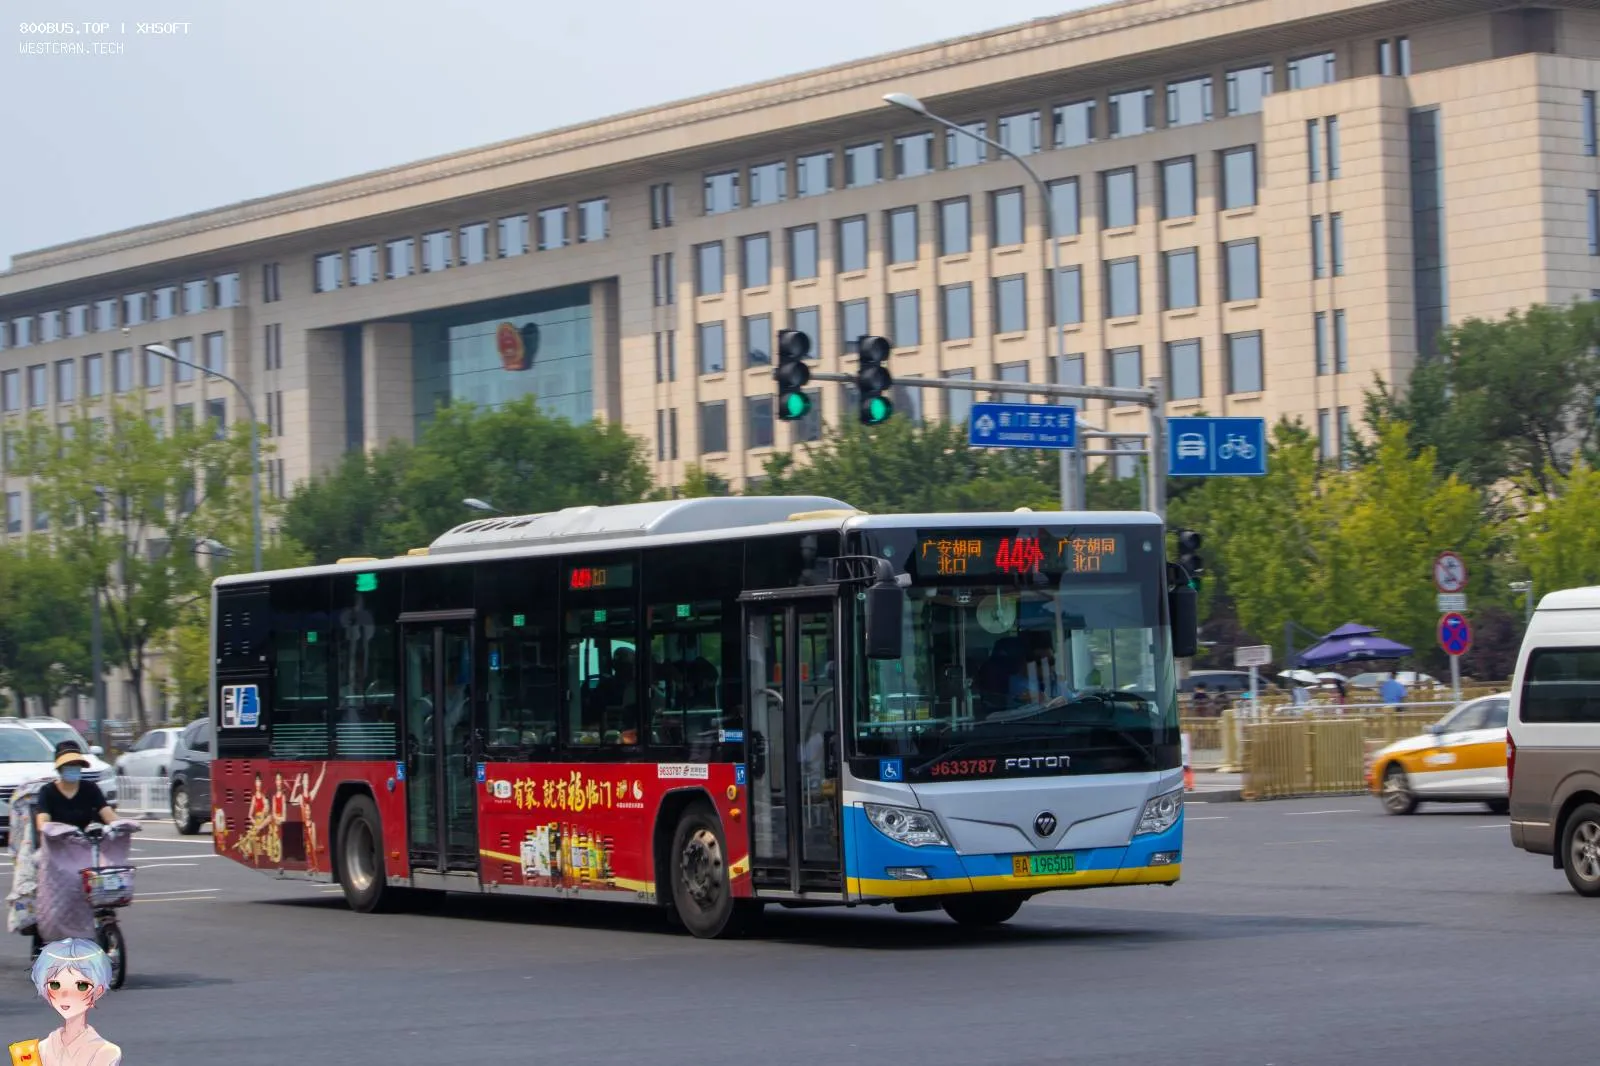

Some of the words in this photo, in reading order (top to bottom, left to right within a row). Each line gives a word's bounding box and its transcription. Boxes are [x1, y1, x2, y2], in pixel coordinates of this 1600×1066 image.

[922, 539, 982, 558] 广安胡同
[1057, 538, 1116, 557] 广安胡同
[937, 557, 967, 574] 北口
[1072, 555, 1101, 572] 北口
[931, 758, 997, 776] 9633787
[1005, 755, 1071, 770] FOTON
